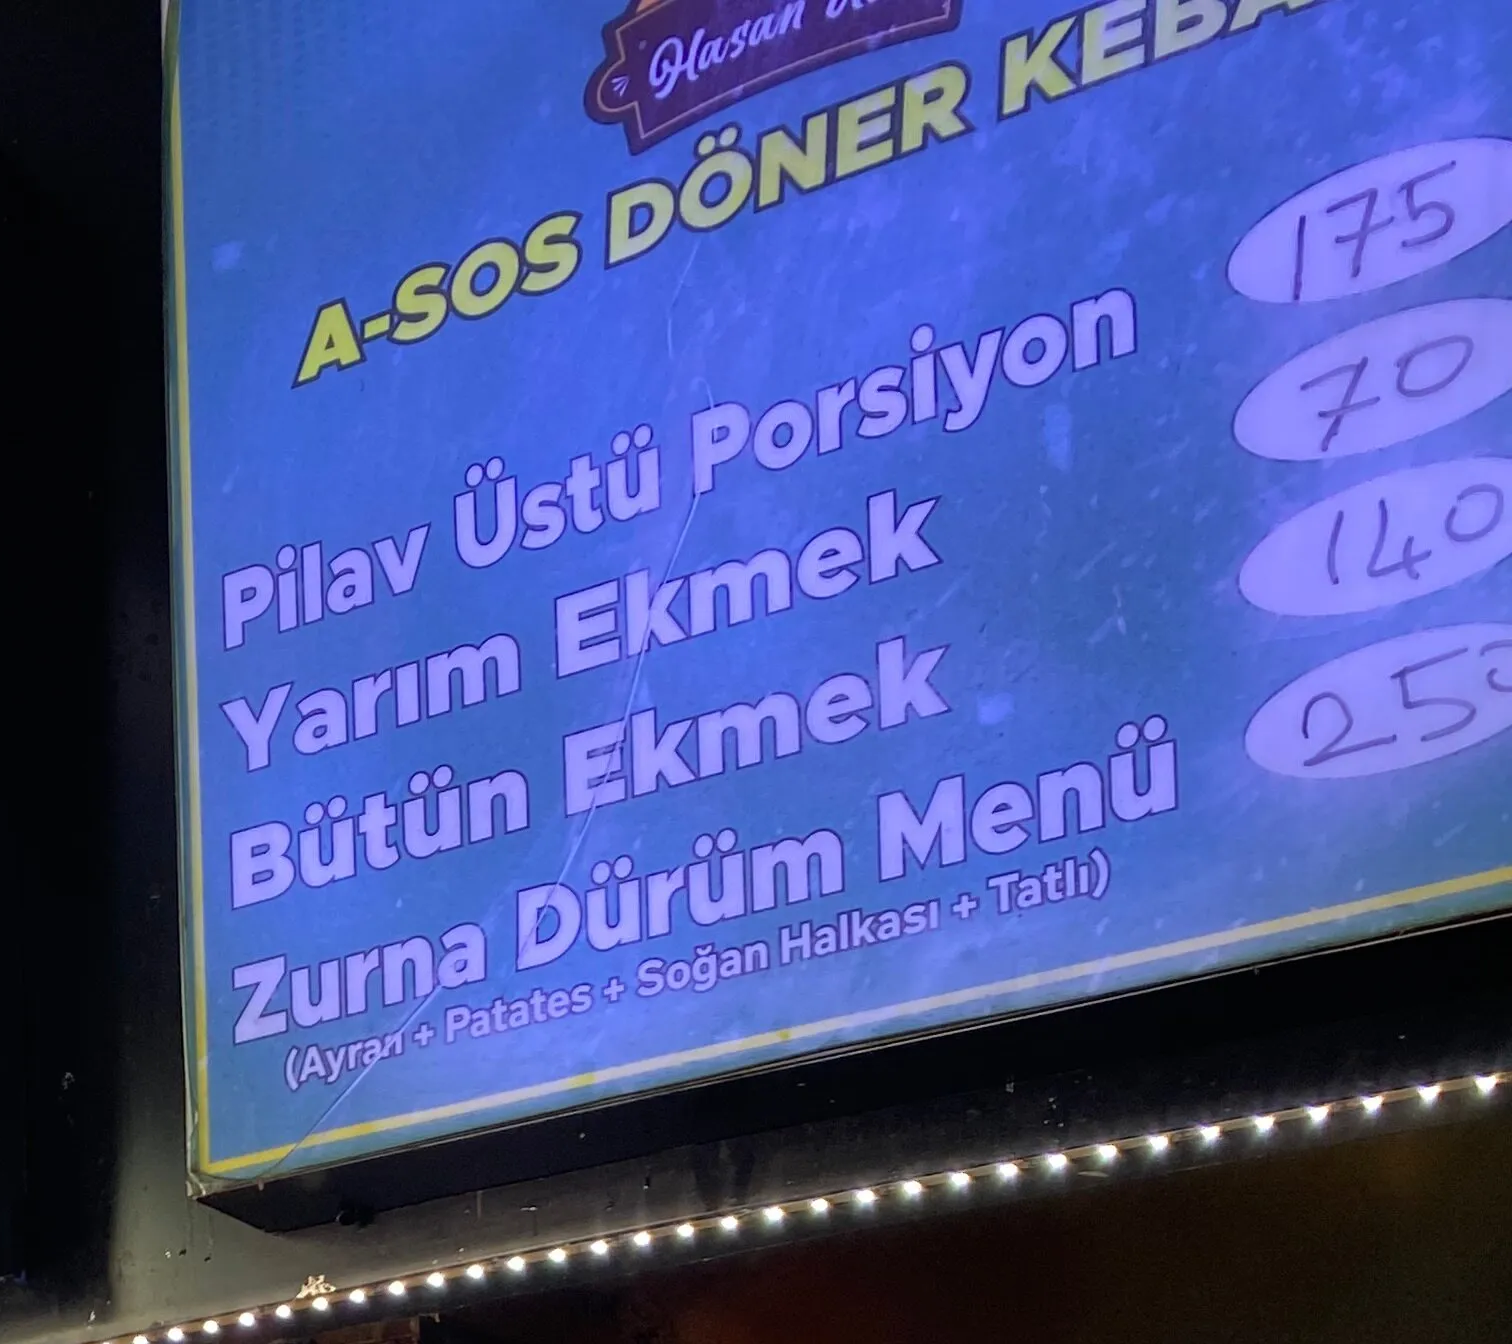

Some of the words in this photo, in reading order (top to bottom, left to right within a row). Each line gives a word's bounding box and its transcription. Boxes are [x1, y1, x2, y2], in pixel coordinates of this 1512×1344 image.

[292, 211, 583, 388] A-SOS
[604, 61, 975, 270] DÖNER
[1291, 161, 1457, 302] 175
[222, 524, 431, 652] Pilav
[453, 424, 661, 569] Üstü
[691, 287, 1137, 498] Porsiyon
[1300, 335, 1475, 452] 70
[220, 633, 522, 772] Yarım
[554, 489, 942, 679] Ekmek
[1324, 484, 1503, 586] 140
[230, 765, 529, 909] Bütün
[563, 637, 951, 818] Ekmek
[233, 921, 487, 1045] Zurna
[516, 828, 843, 971] Dürüm
[878, 715, 1179, 882] Menü
[284, 1028, 403, 1090] (Ayran
[413, 1022, 434, 1046] +
[443, 980, 591, 1045] Patates
[604, 978, 625, 1003] +
[636, 932, 769, 995] Soğan
[779, 898, 941, 965] Halkası
[951, 894, 979, 920] +
[987, 847, 1111, 914] Tatlı)
